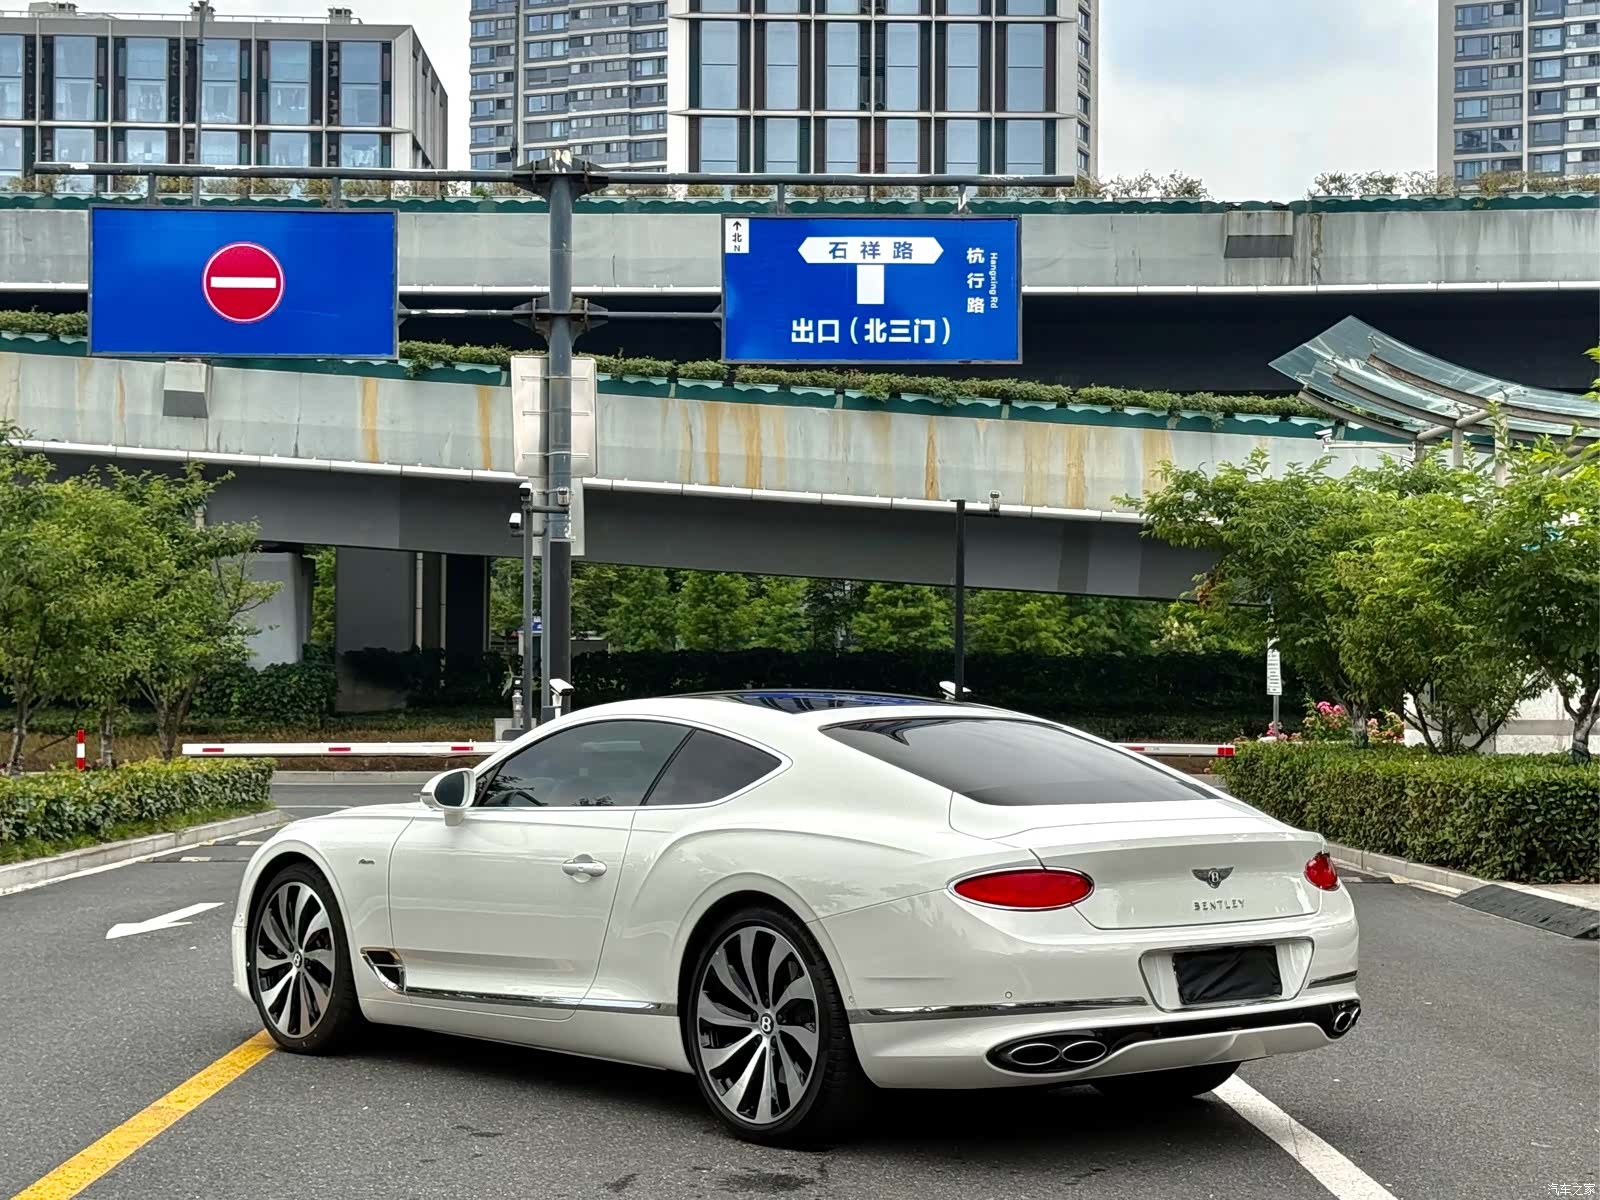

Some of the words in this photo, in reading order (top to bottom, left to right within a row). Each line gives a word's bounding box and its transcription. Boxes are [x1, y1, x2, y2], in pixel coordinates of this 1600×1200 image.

[731, 232, 743, 243] 北
[733, 244, 741, 252] N
[828, 241, 914, 260] 石祥路
[966, 247, 985, 314] 杭行路
[988, 252, 999, 296] Hangxing
[990, 296, 999, 309] Rd
[1194, 899, 1244, 911] BENTLEY
